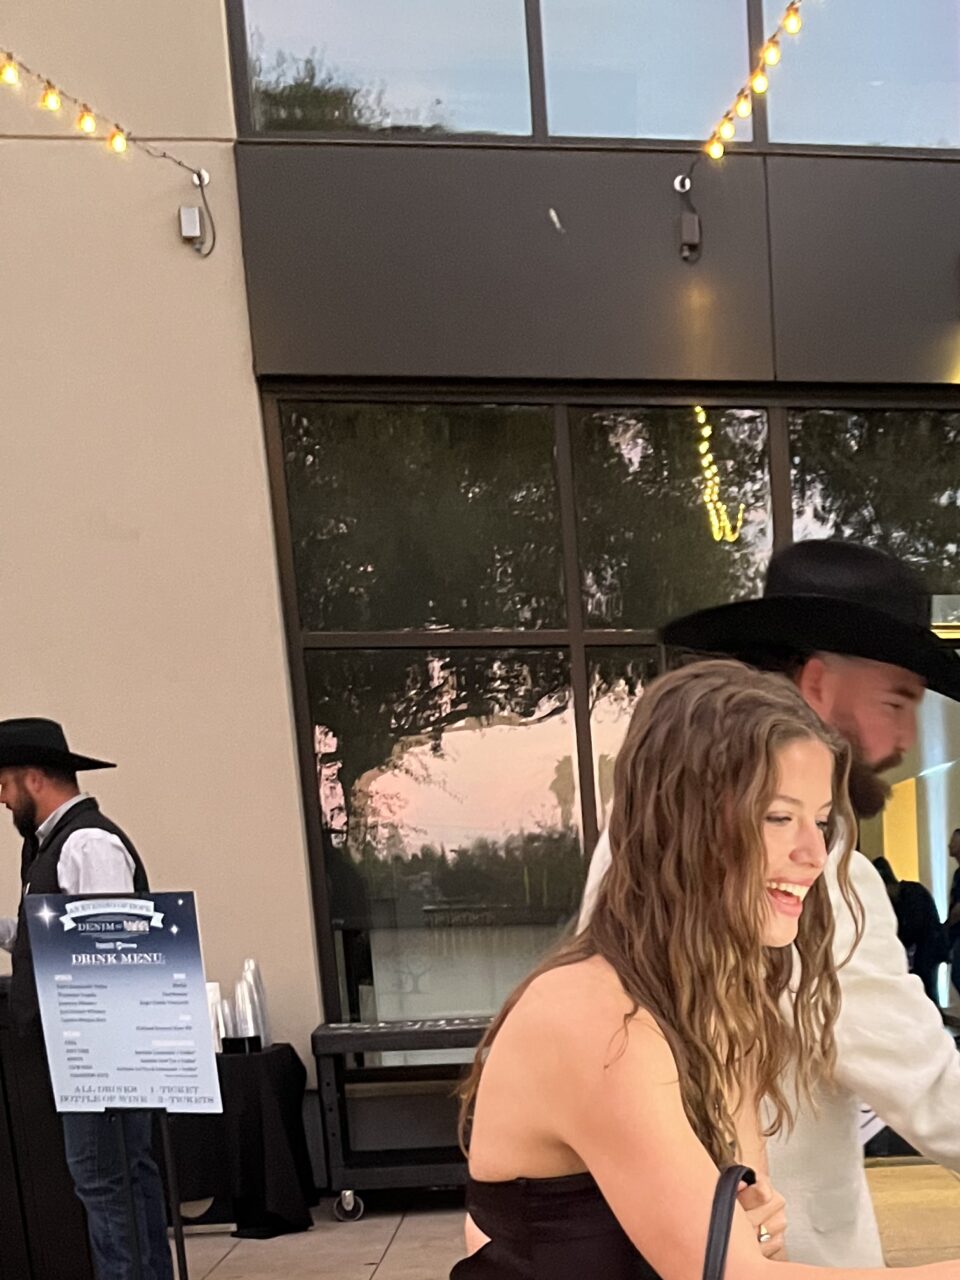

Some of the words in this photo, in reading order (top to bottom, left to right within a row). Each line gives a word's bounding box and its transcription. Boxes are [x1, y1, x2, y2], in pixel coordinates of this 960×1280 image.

[77, 922, 115, 932] DENIM
[71, 953, 117, 966] DRINK
[119, 952, 165, 966] MENU
[74, 1085, 96, 1094] ALL
[97, 1085, 138, 1094] DRINKS
[160, 1085, 200, 1095] TICKET
[60, 1095, 98, 1104] BOTTLE
[101, 1095, 117, 1104] OF
[118, 1095, 148, 1104] WINE
[168, 1095, 215, 1105] TICKETS
